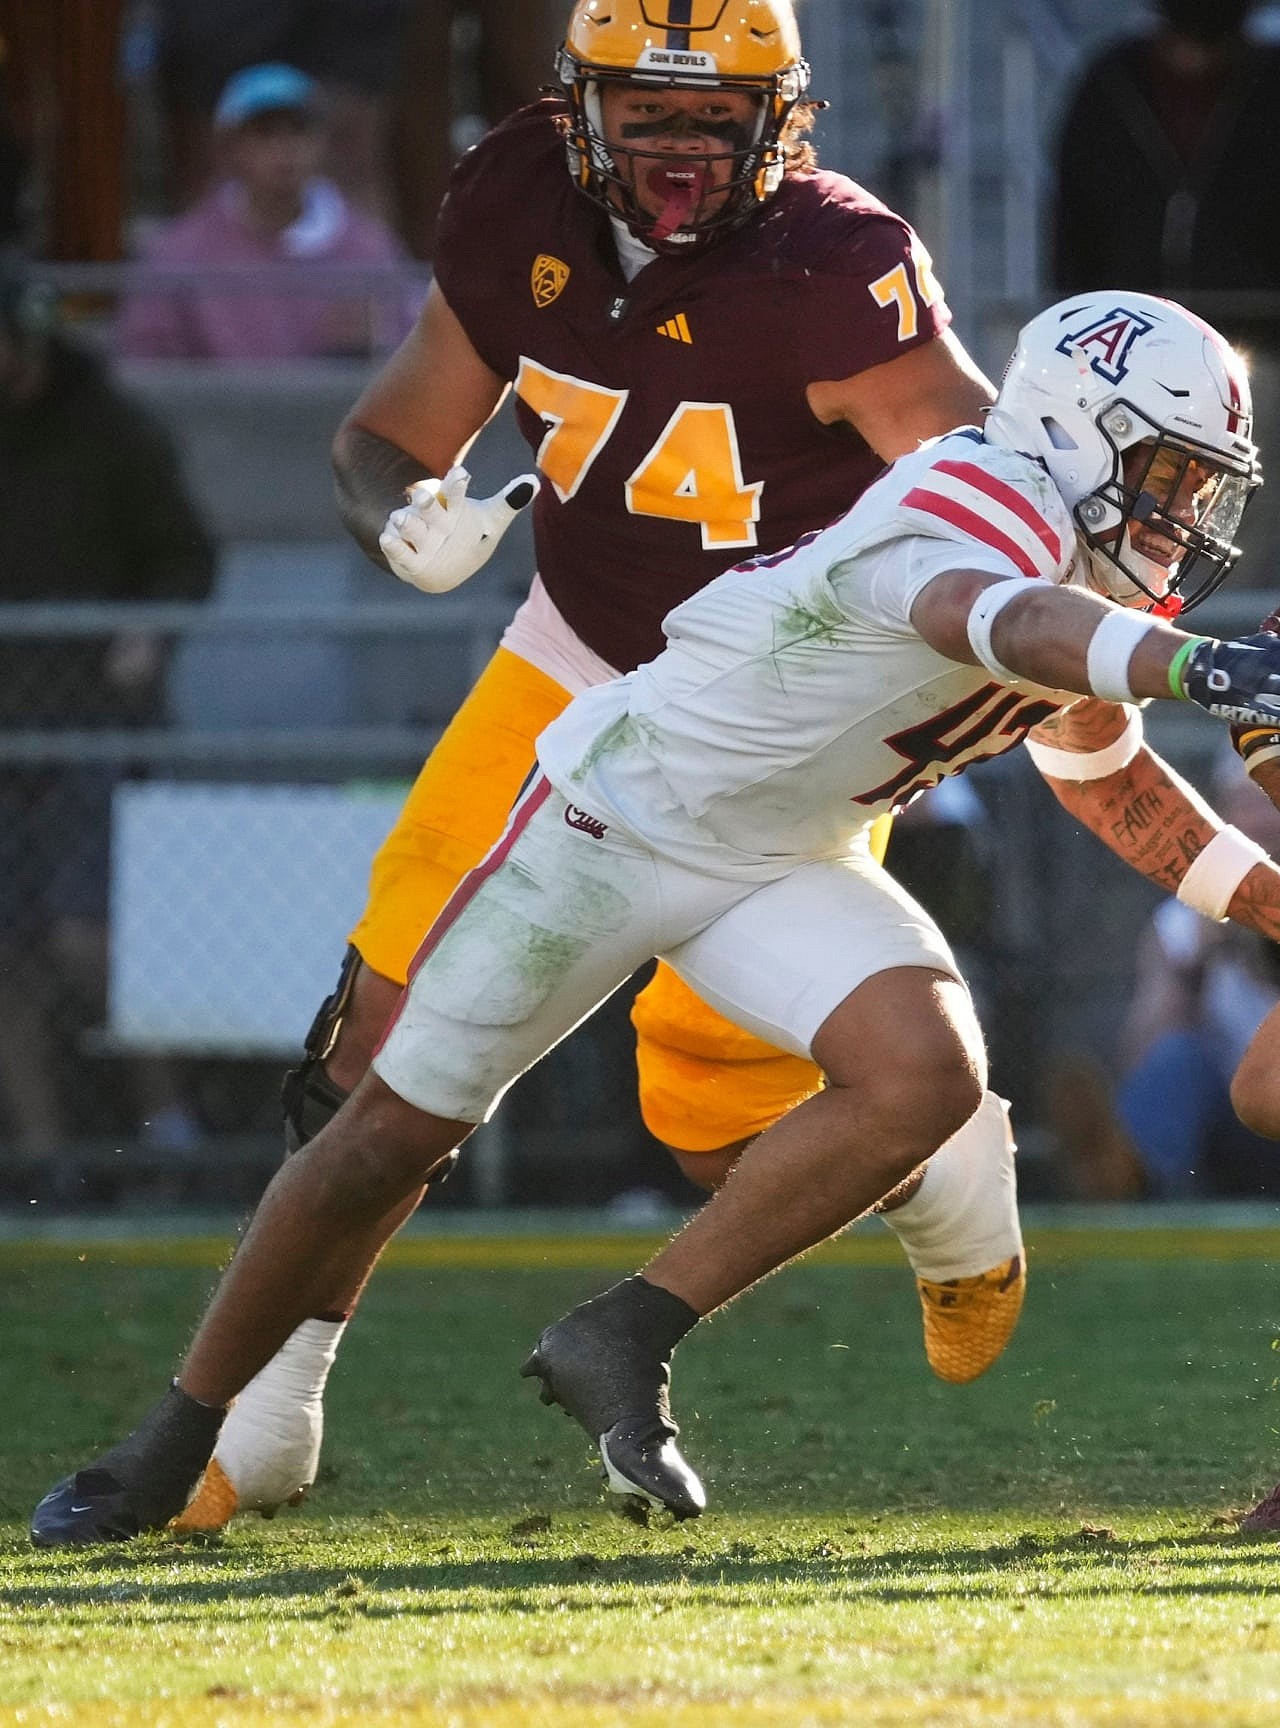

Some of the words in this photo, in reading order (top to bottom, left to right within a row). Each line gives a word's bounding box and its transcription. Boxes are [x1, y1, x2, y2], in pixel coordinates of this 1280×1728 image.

[649, 52, 670, 63] SUN
[673, 54, 706, 66] DEVILS
[536, 278, 554, 299] 12
[1055, 307, 1155, 386] A
[513, 355, 765, 550] 74
[1110, 786, 1164, 848] FAITH
